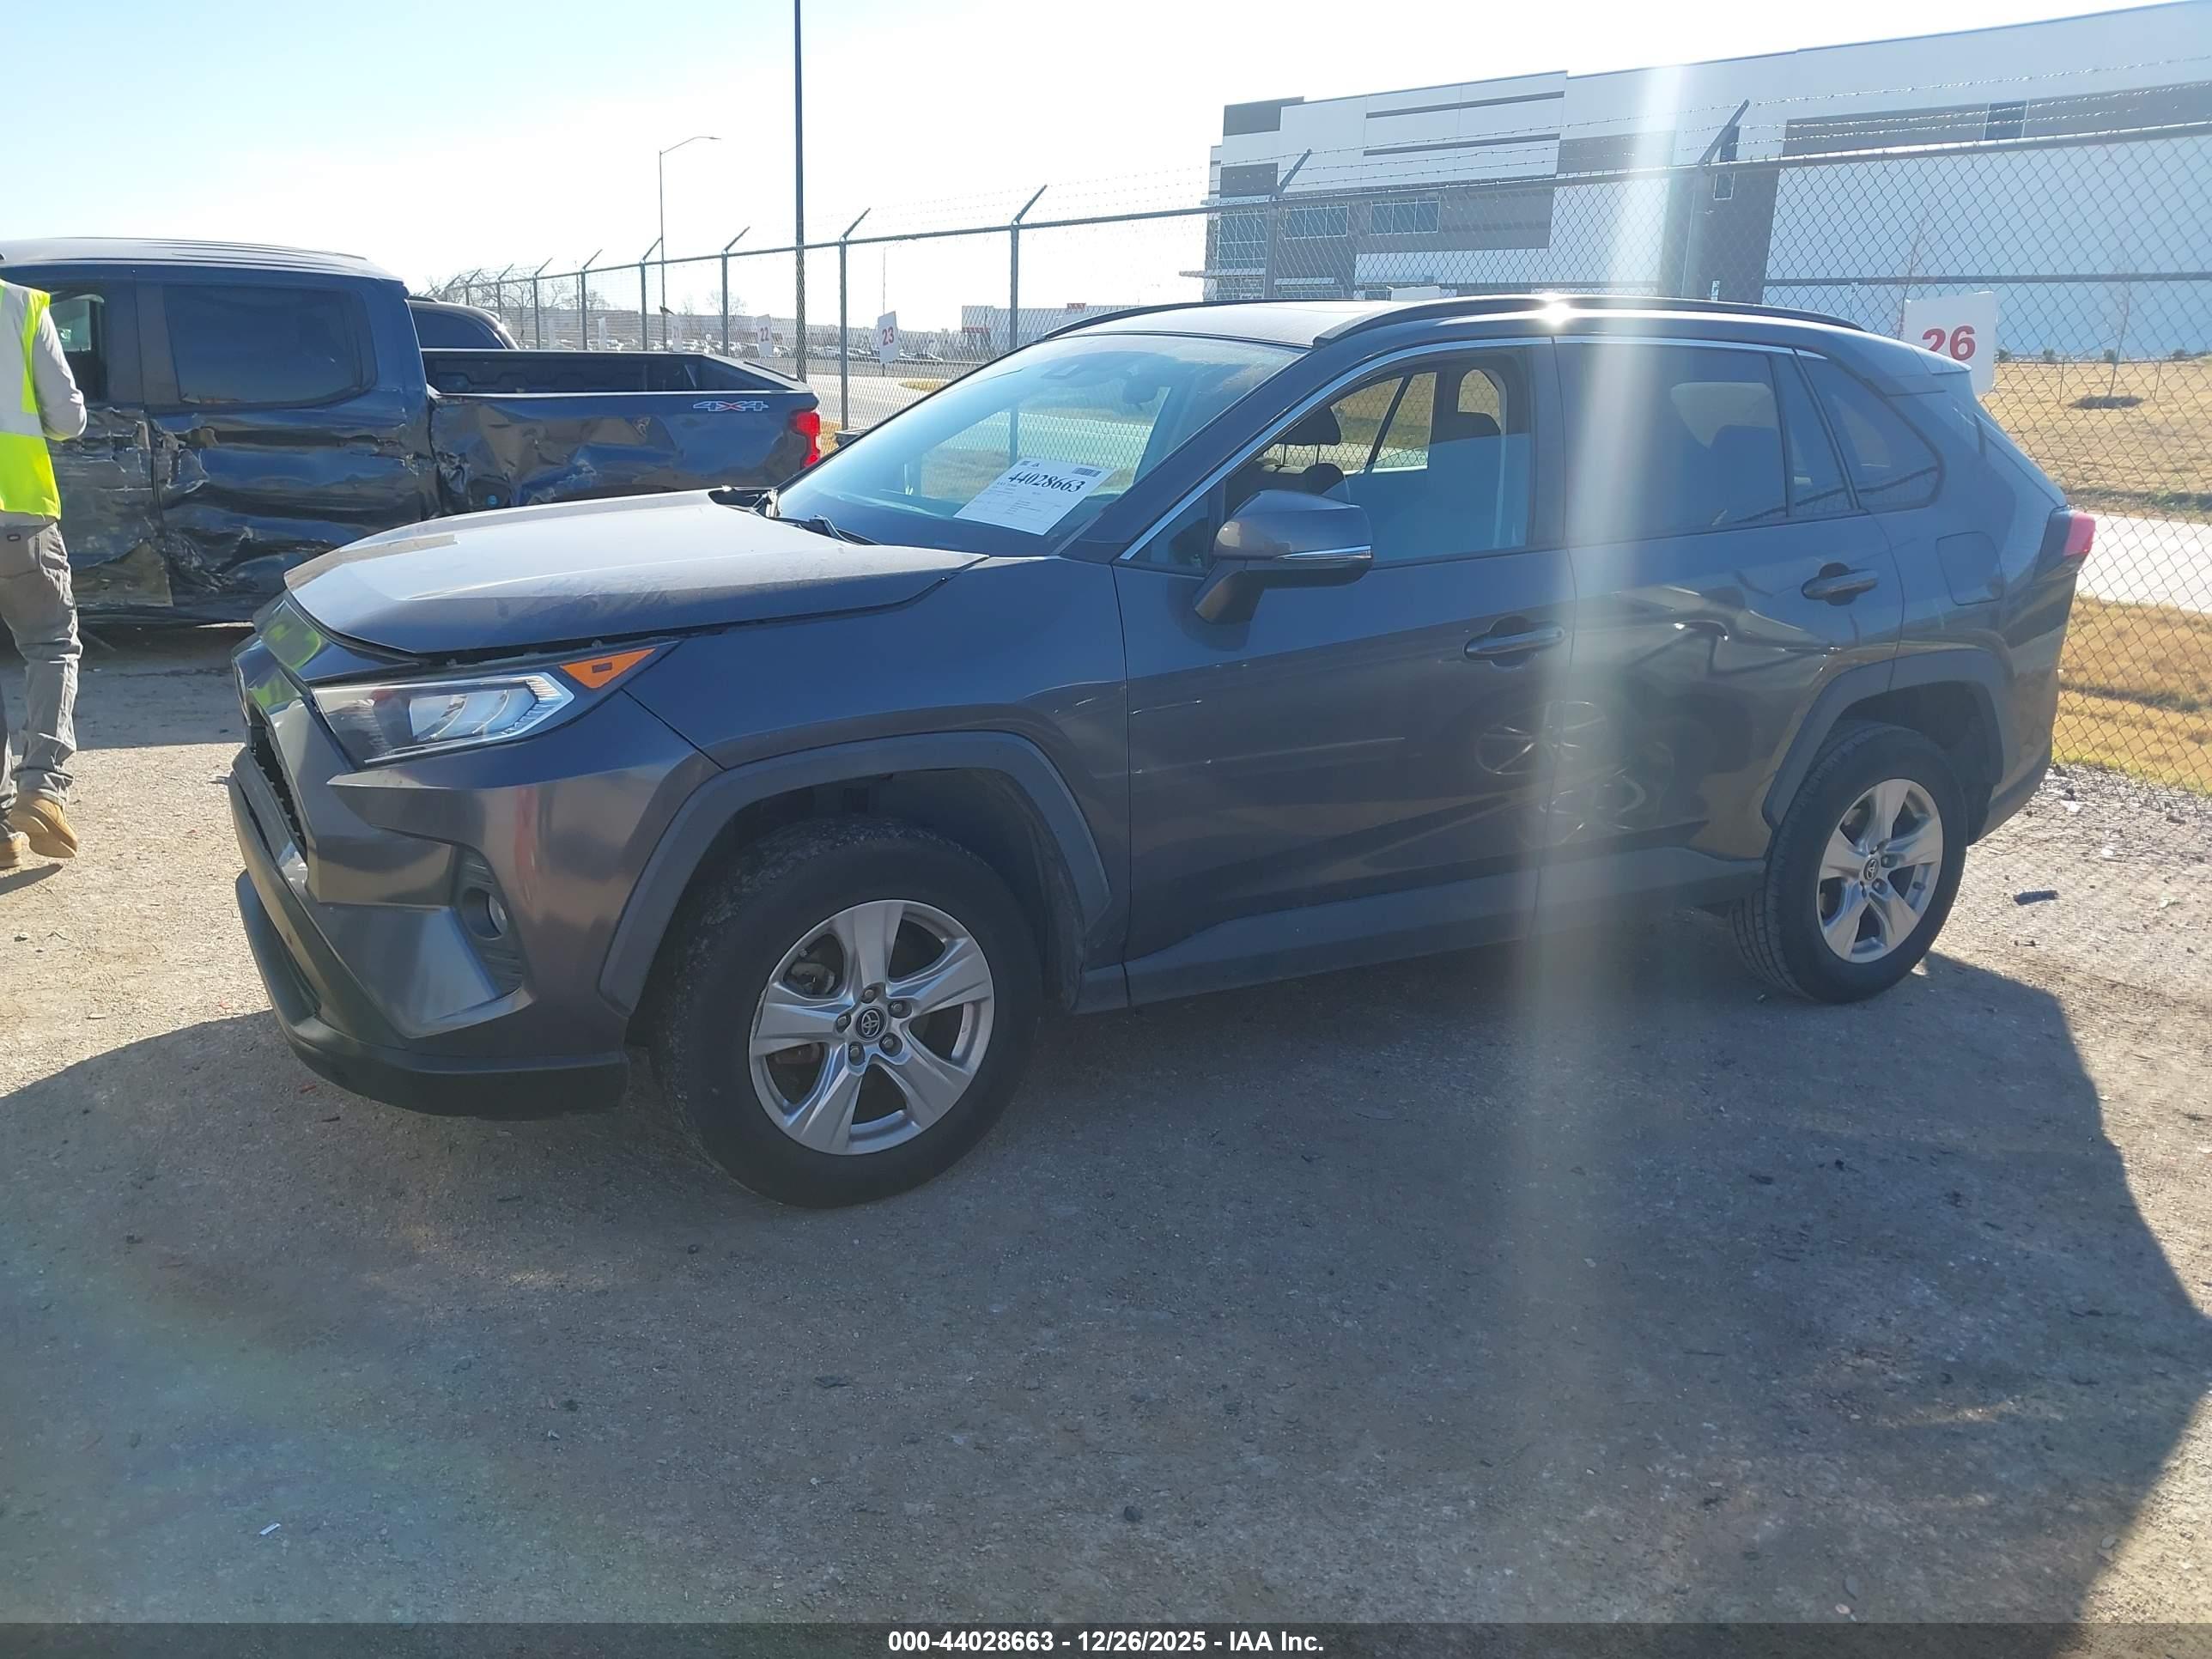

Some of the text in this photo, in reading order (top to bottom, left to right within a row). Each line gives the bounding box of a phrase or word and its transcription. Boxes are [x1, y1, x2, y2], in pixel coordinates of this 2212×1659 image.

[882, 325, 895, 346] 23
[1922, 325, 1976, 362] 26
[1008, 471, 1086, 492] 44028663
